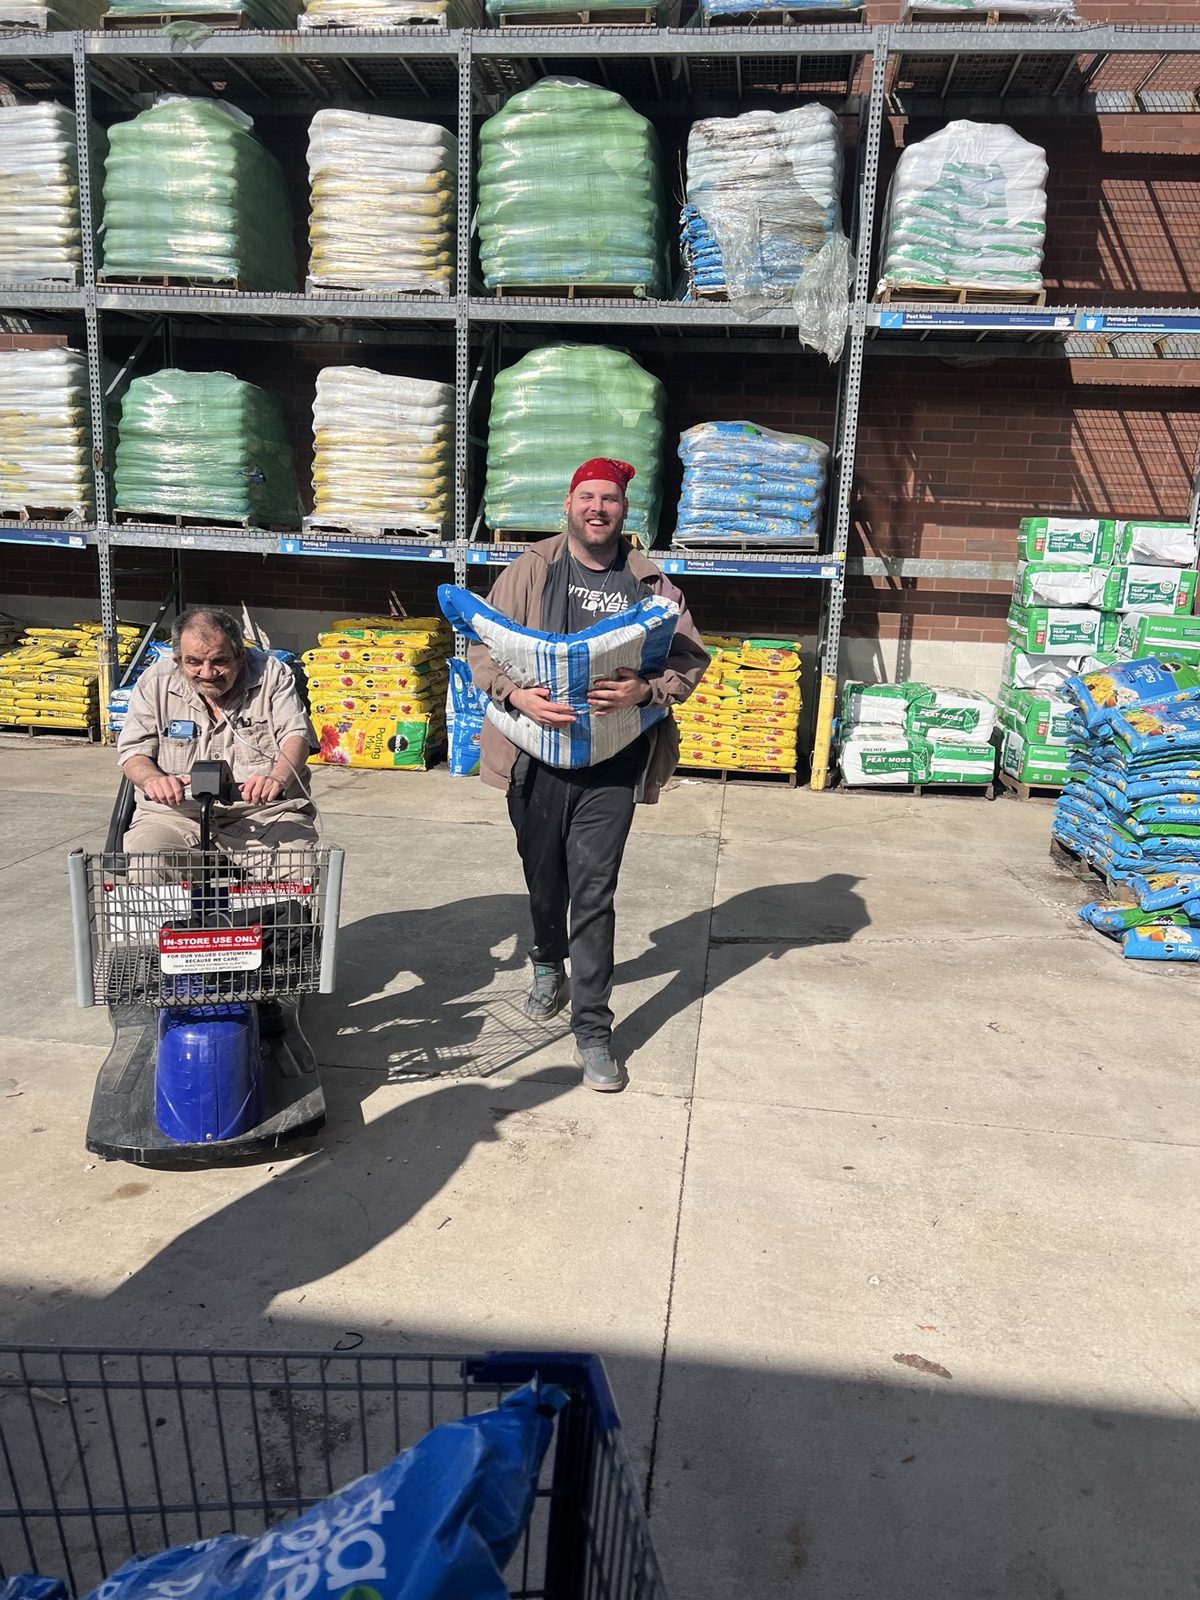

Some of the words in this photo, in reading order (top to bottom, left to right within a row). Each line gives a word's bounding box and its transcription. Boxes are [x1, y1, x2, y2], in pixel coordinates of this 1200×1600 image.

[919, 709, 941, 718] PEAT
[941, 713, 964, 722] MOSS
[365, 735, 375, 751] Mix
[371, 727, 386, 760] Potting
[1178, 945, 1200, 954] Pottin
